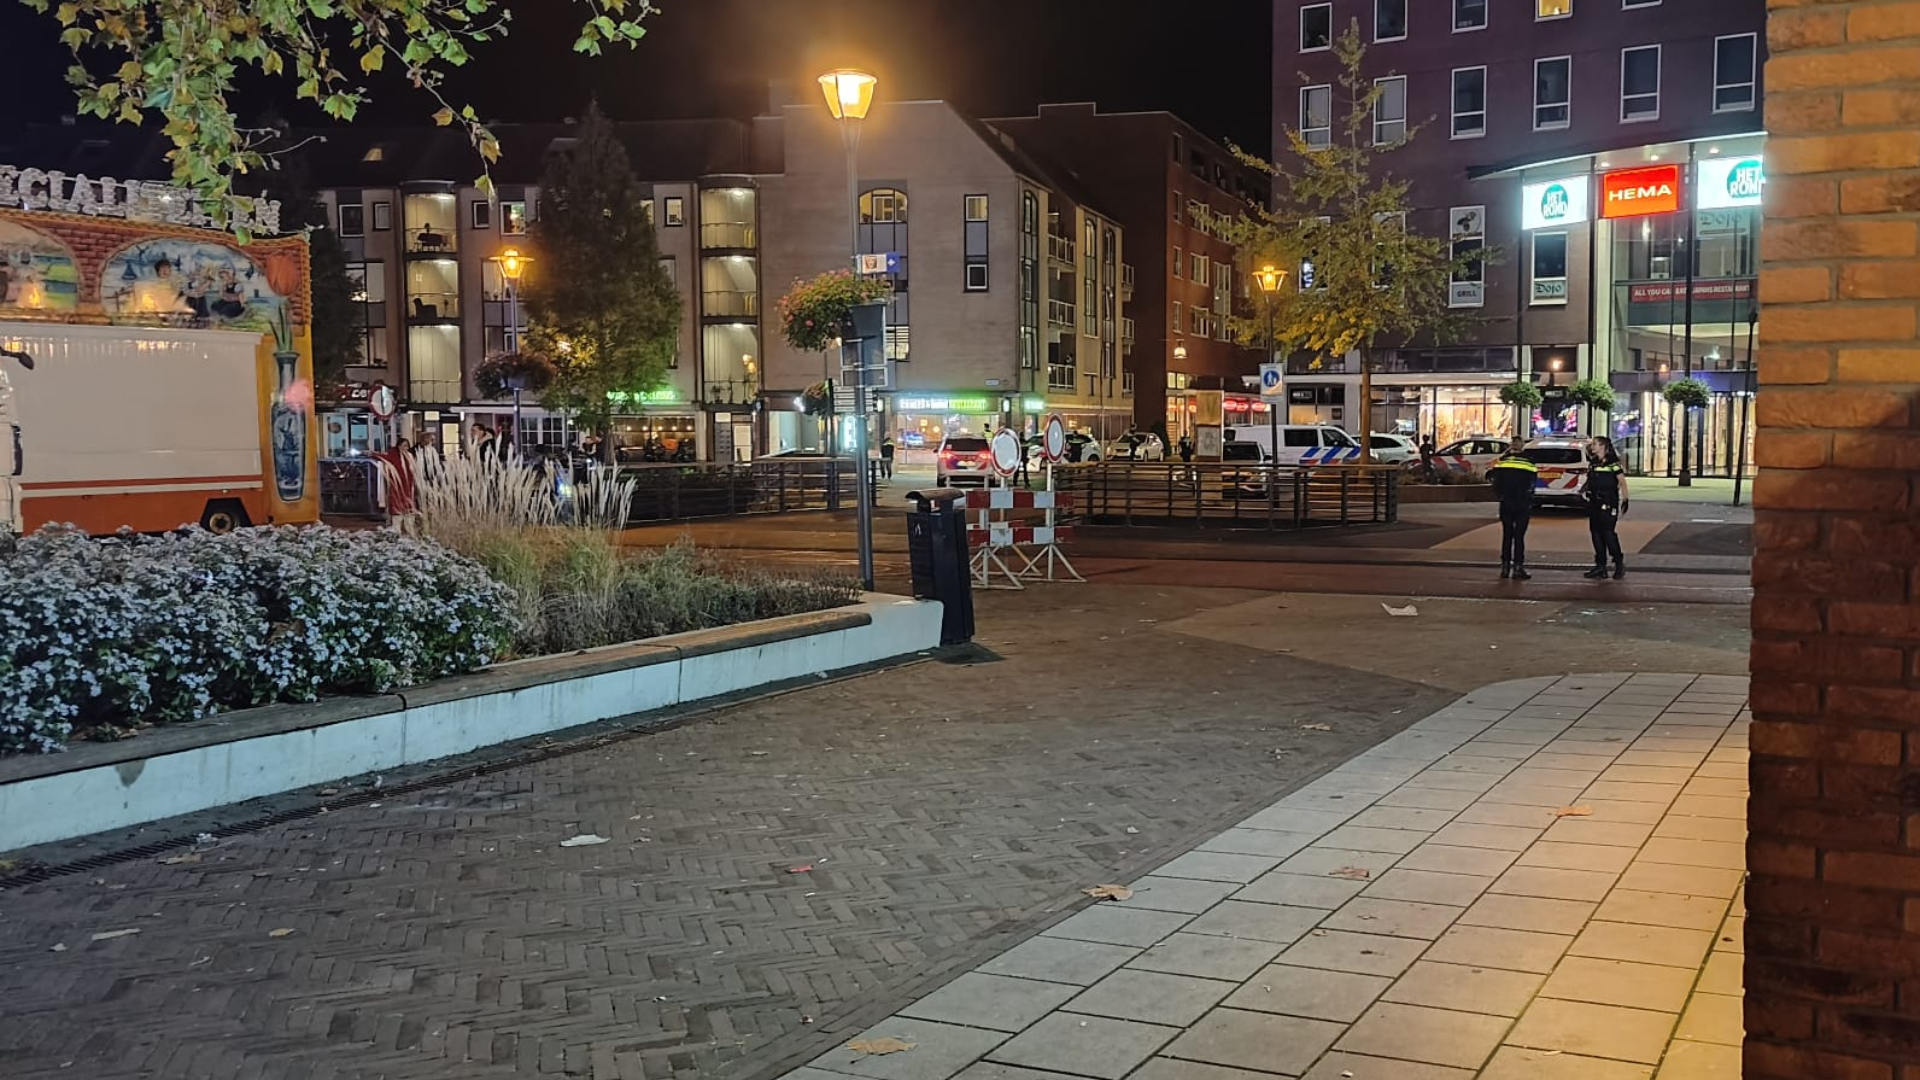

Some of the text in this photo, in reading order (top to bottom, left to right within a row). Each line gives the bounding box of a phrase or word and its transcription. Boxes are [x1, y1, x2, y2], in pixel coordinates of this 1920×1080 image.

[1737, 167, 1761, 183] HET
[1546, 190, 1564, 204] HET
[1608, 183, 1672, 201] HEMA
[1543, 201, 1567, 217] ROND
